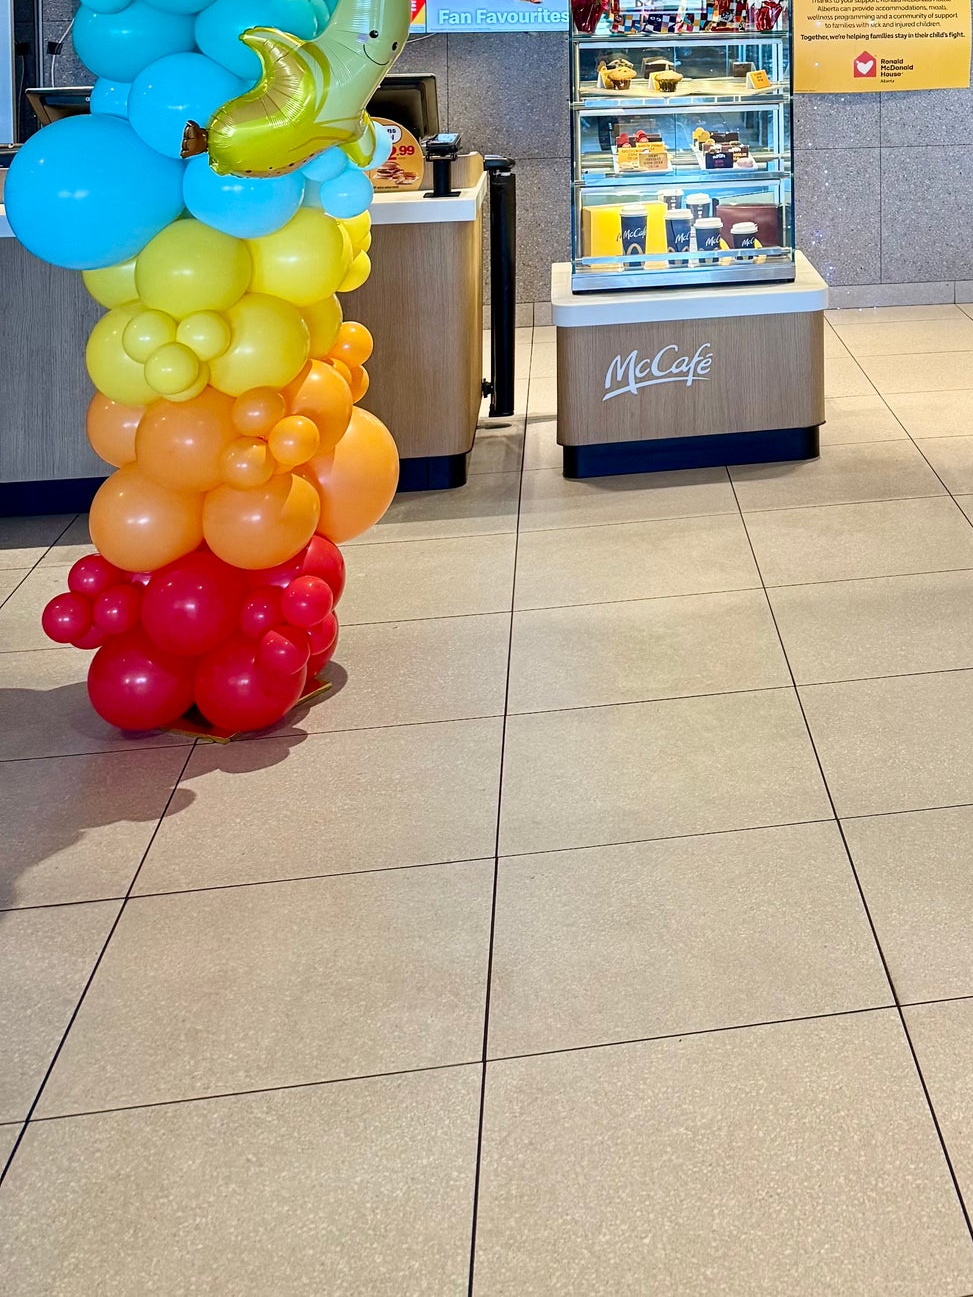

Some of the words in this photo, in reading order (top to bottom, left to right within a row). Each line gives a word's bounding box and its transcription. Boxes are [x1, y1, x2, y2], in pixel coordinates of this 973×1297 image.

[439, 10, 472, 24] Fan
[476, 8, 569, 24] Favourites
[604, 343, 713, 396] McCafé
